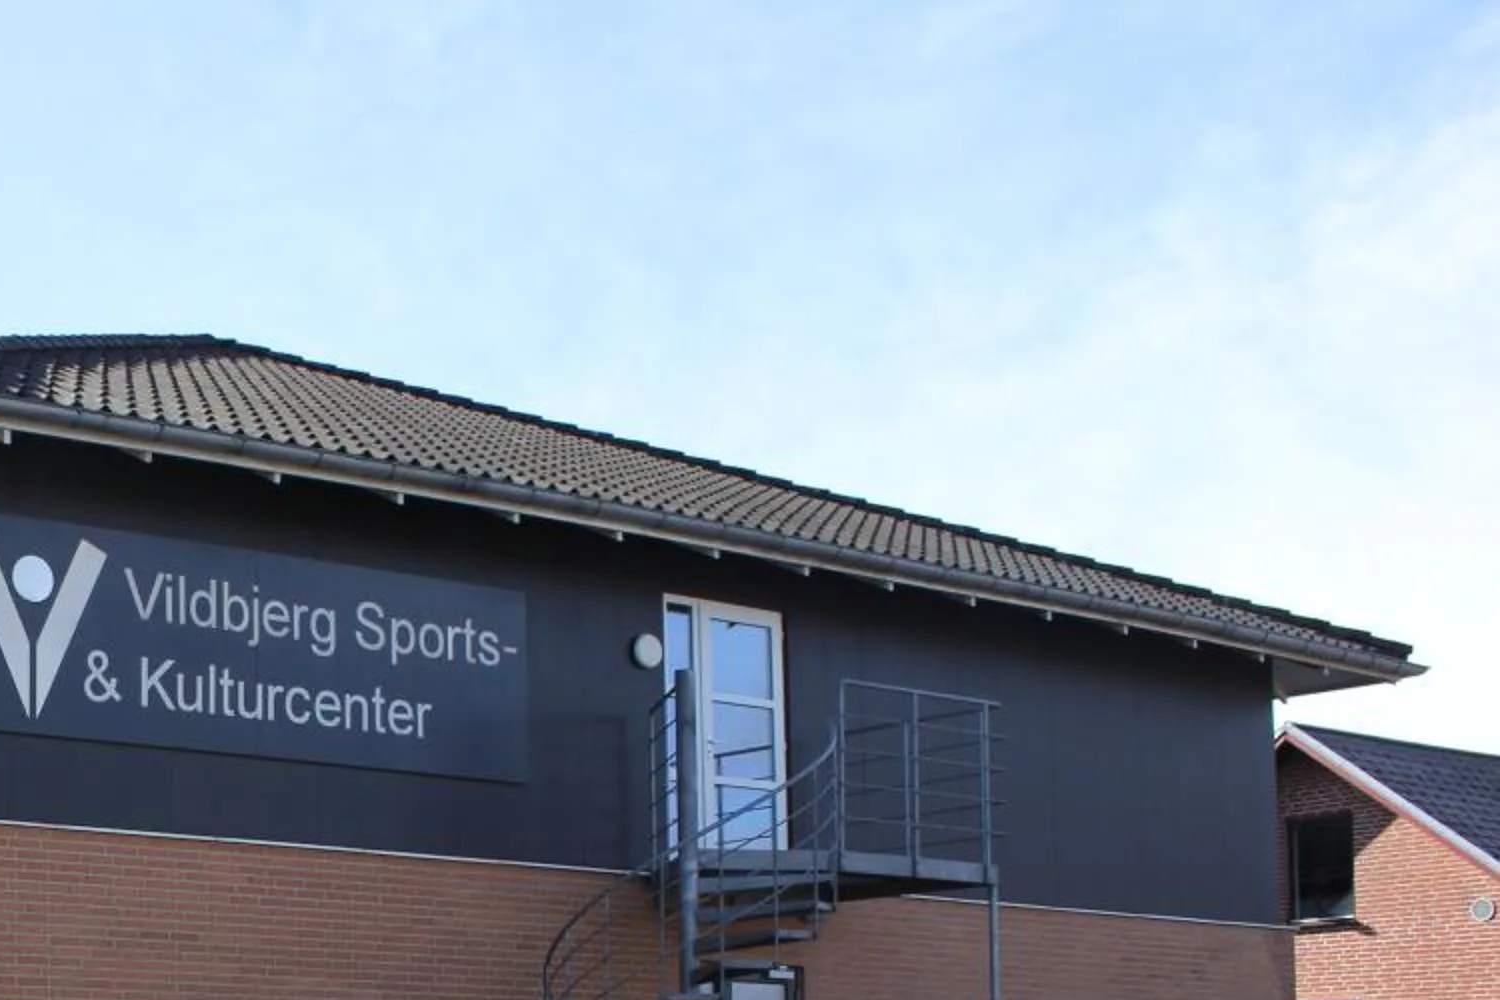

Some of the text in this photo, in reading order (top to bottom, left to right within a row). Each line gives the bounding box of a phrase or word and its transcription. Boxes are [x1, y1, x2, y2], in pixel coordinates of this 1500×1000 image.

[124, 567, 518, 666] Vildbjerg Sports-
[84, 650, 432, 739] & Kulturcenter
